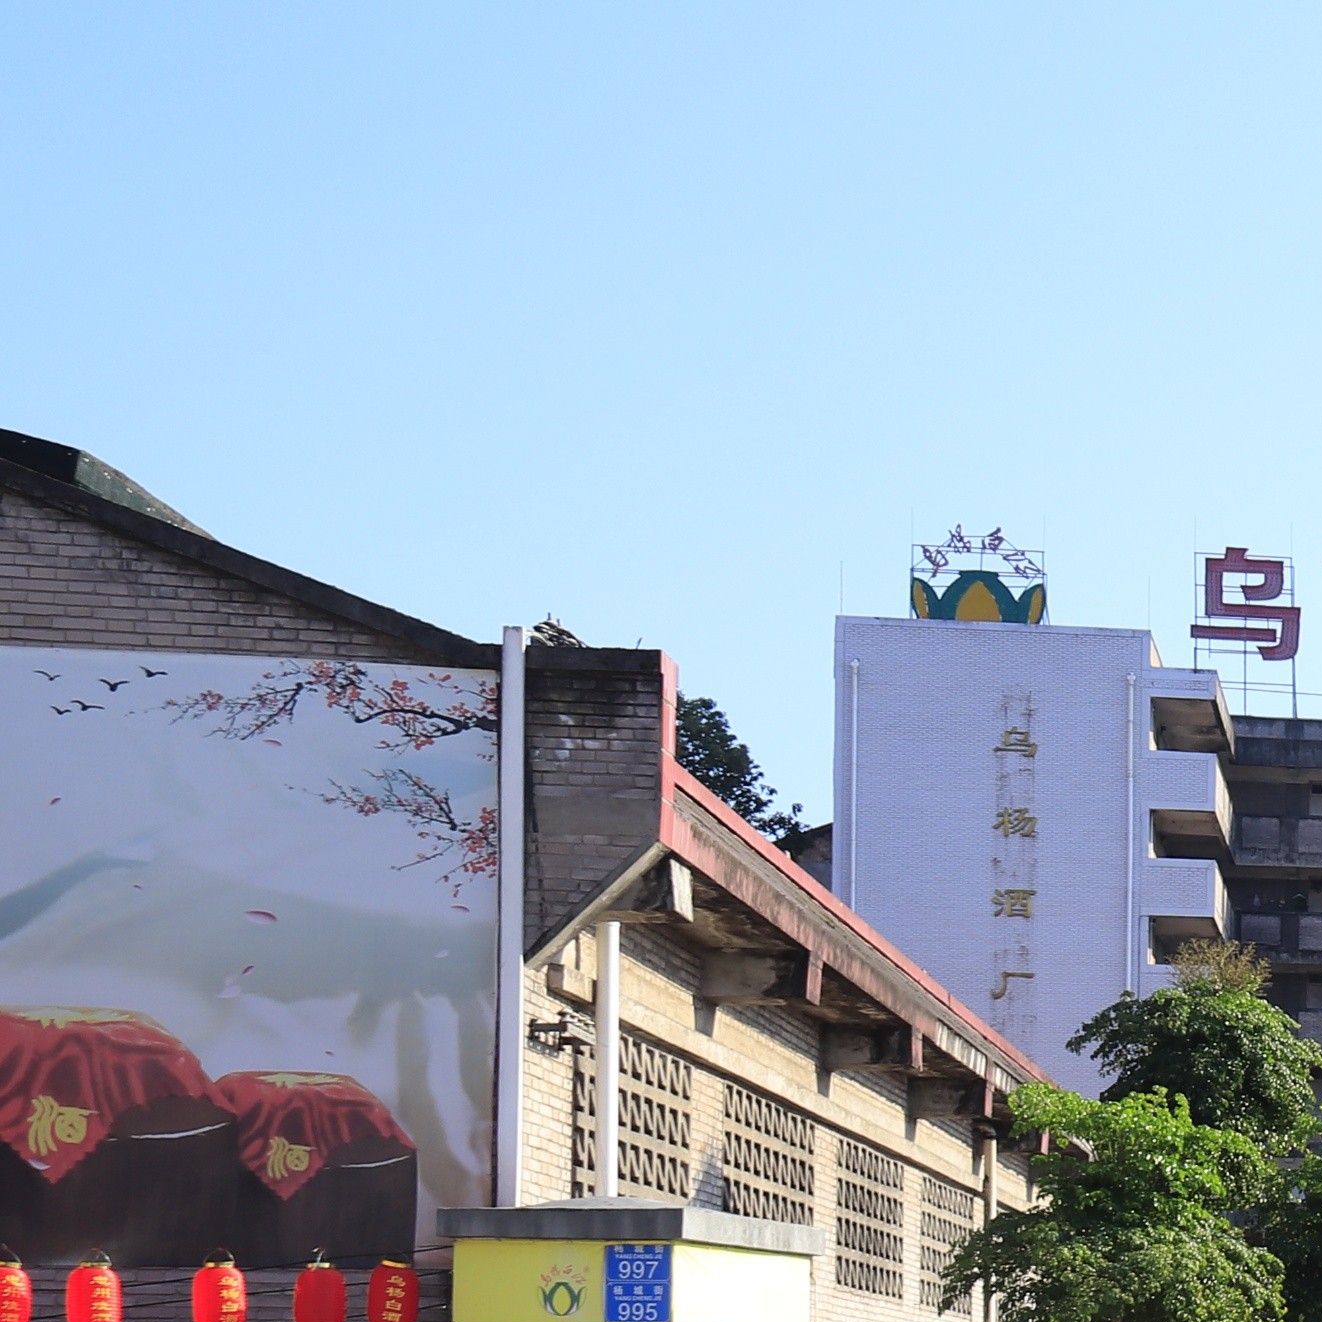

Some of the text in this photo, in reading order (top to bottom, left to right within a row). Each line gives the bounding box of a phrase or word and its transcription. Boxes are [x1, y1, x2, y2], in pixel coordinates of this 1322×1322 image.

[991, 726, 1039, 1000] 乌杨酒厂
[618, 1260, 659, 1279] 997
[381, 1275, 406, 1322] 乌杨白酒
[612, 1285, 664, 1295] 杨城街
[618, 1302, 658, 1321] 995
